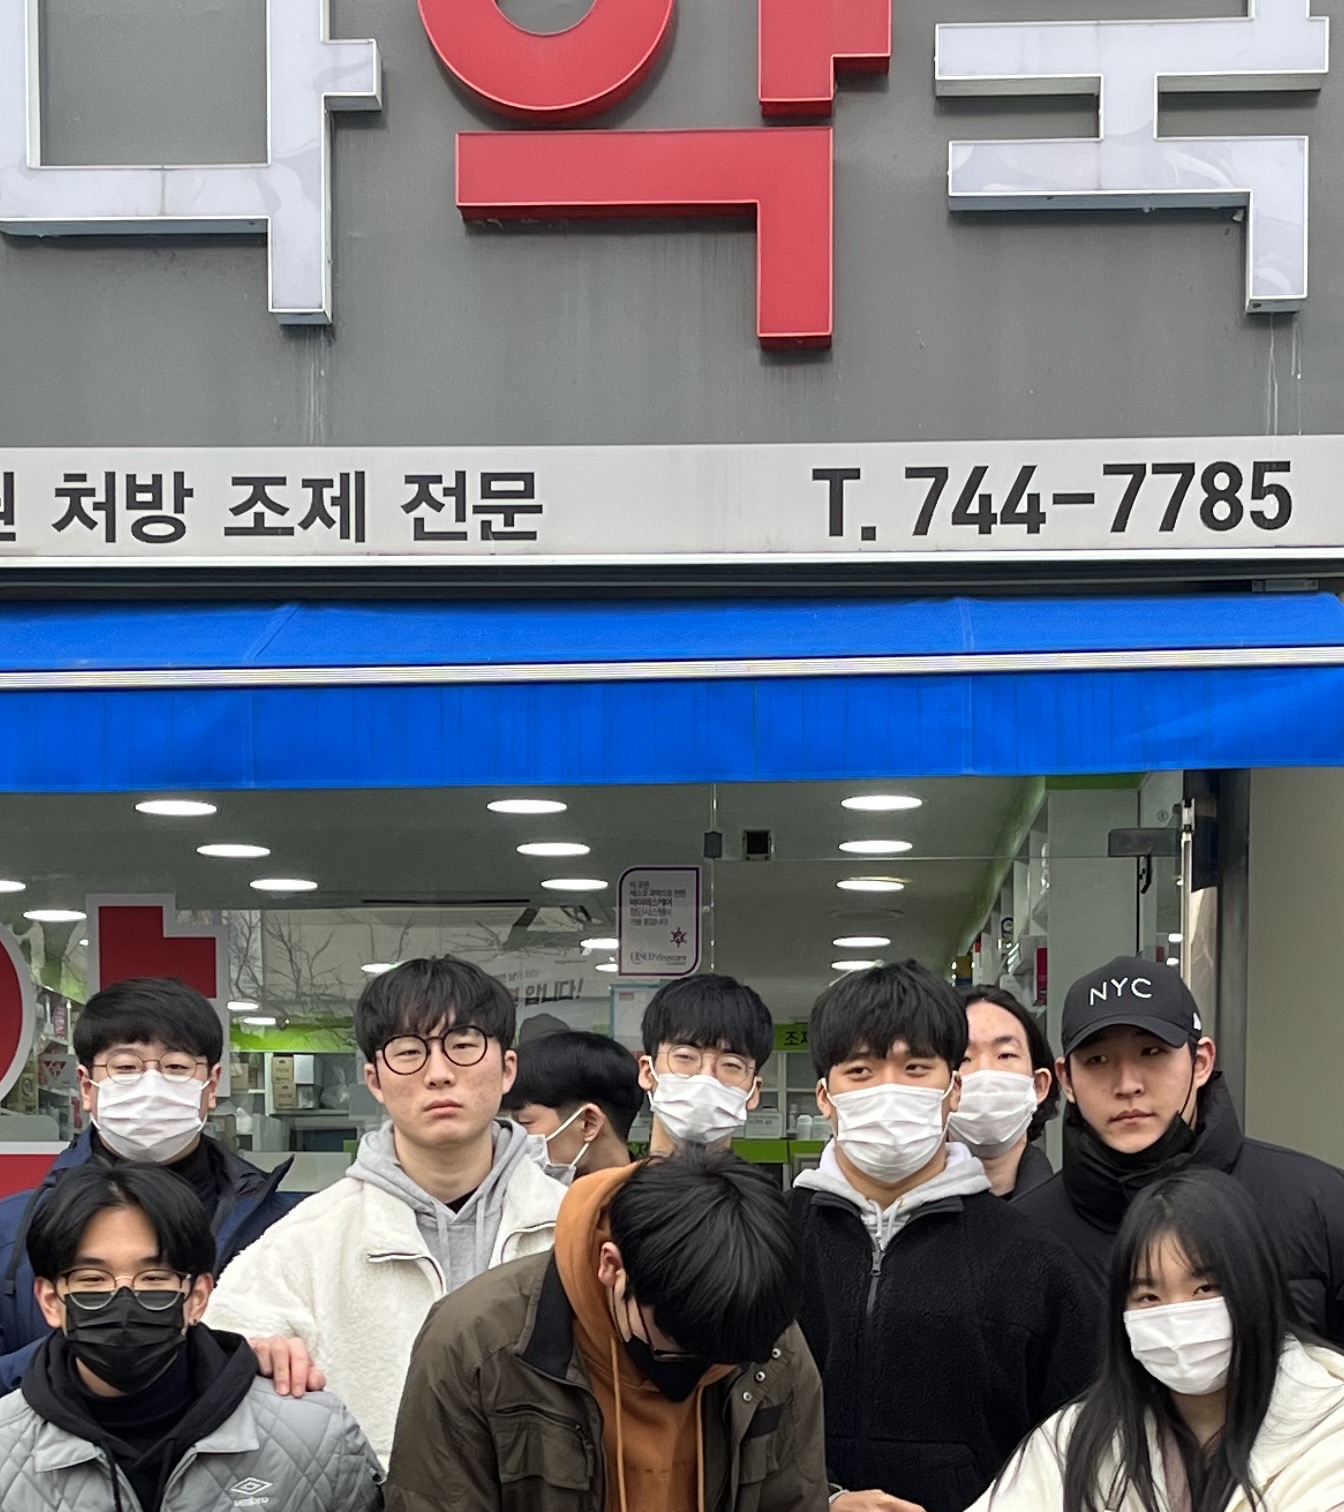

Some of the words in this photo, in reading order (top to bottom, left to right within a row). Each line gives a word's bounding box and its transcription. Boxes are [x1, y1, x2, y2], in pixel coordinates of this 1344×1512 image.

[51, 470, 195, 544] 처방
[223, 470, 368, 543] 조제
[400, 469, 545, 541] 전문
[812, 466, 878, 541] T.
[905, 459, 1294, 536] 744-7785
[1089, 977, 1153, 1006] NYC
